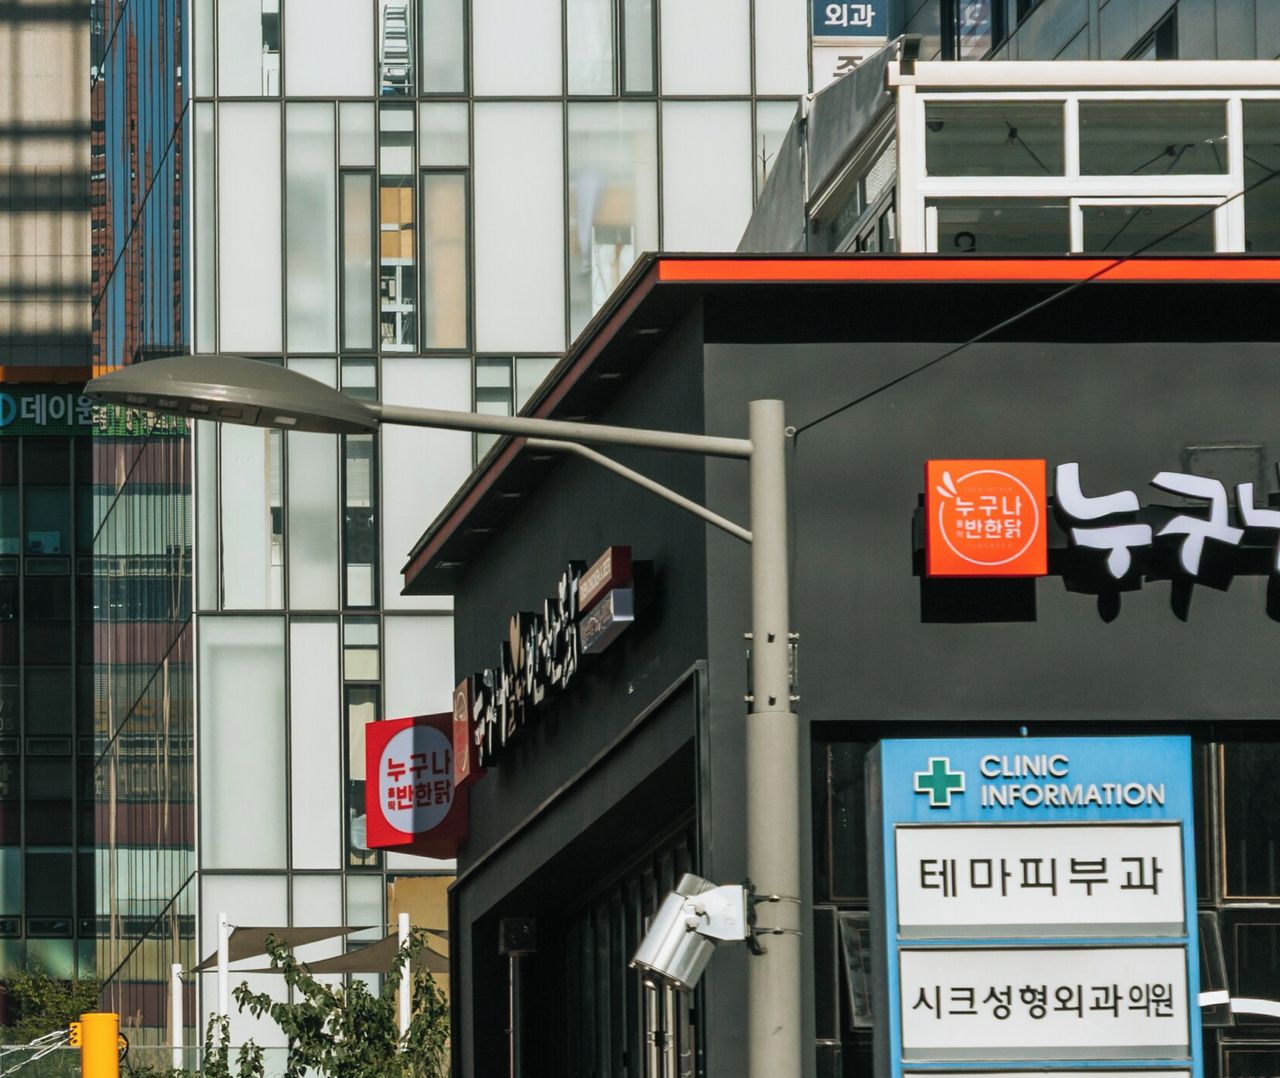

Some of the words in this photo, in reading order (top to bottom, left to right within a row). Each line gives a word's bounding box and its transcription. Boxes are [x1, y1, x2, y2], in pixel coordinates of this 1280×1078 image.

[824, 3, 875, 28] 외과
[955, 495, 1022, 516] 누구나
[965, 519, 1022, 539] 반한닭
[387, 749, 451, 782] 누구나
[980, 755, 1069, 778] CLINIC
[396, 780, 451, 810] 반한닭
[980, 784, 1165, 808] INFORMATION
[920, 857, 1163, 897] 테마피부과
